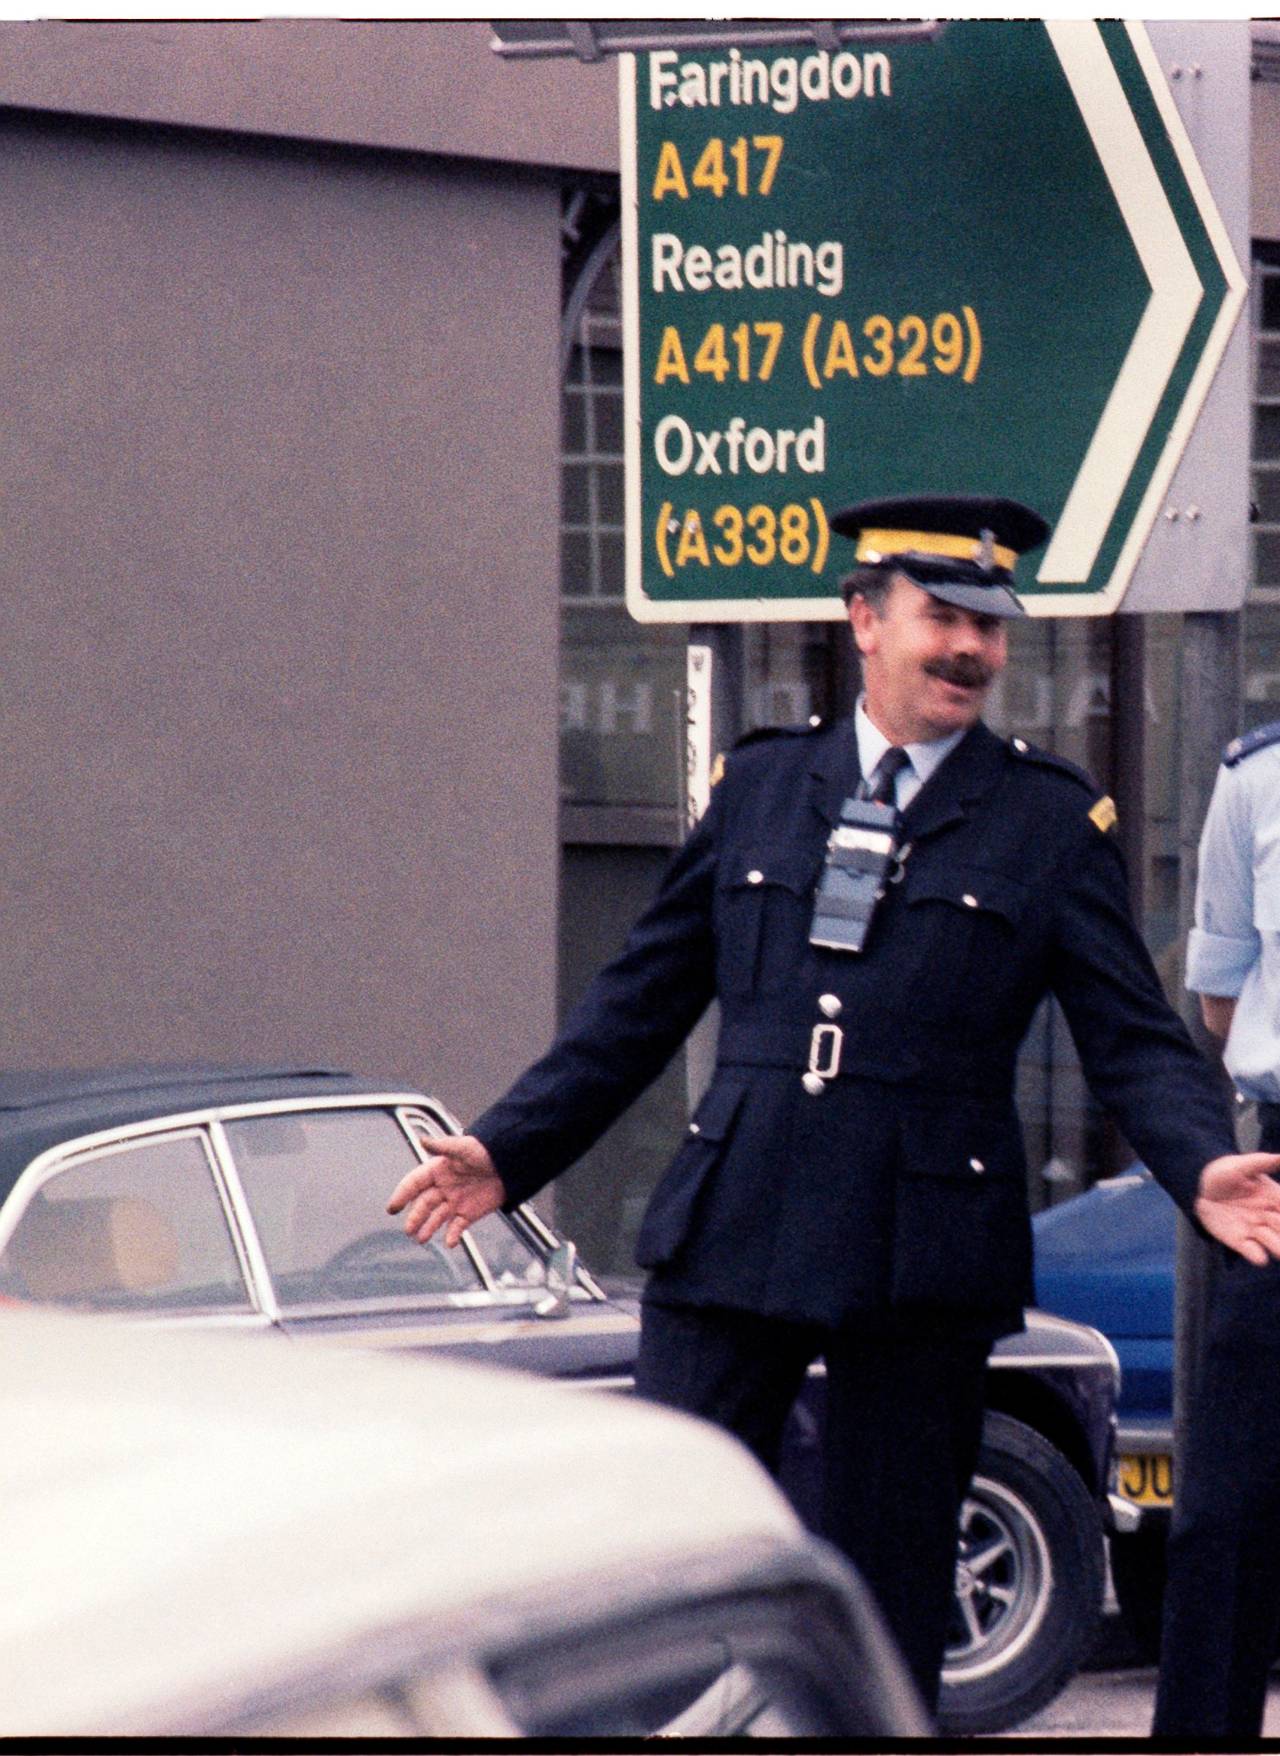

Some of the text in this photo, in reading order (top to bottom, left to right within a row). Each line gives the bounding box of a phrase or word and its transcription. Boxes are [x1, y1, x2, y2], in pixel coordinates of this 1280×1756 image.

[649, 49, 891, 114] Faringdon
[652, 135, 783, 200] A417
[652, 230, 843, 296] Reading
[654, 306, 982, 389] A417 (A329)
[654, 415, 825, 476] Oxford
[656, 498, 830, 577] (A338)
